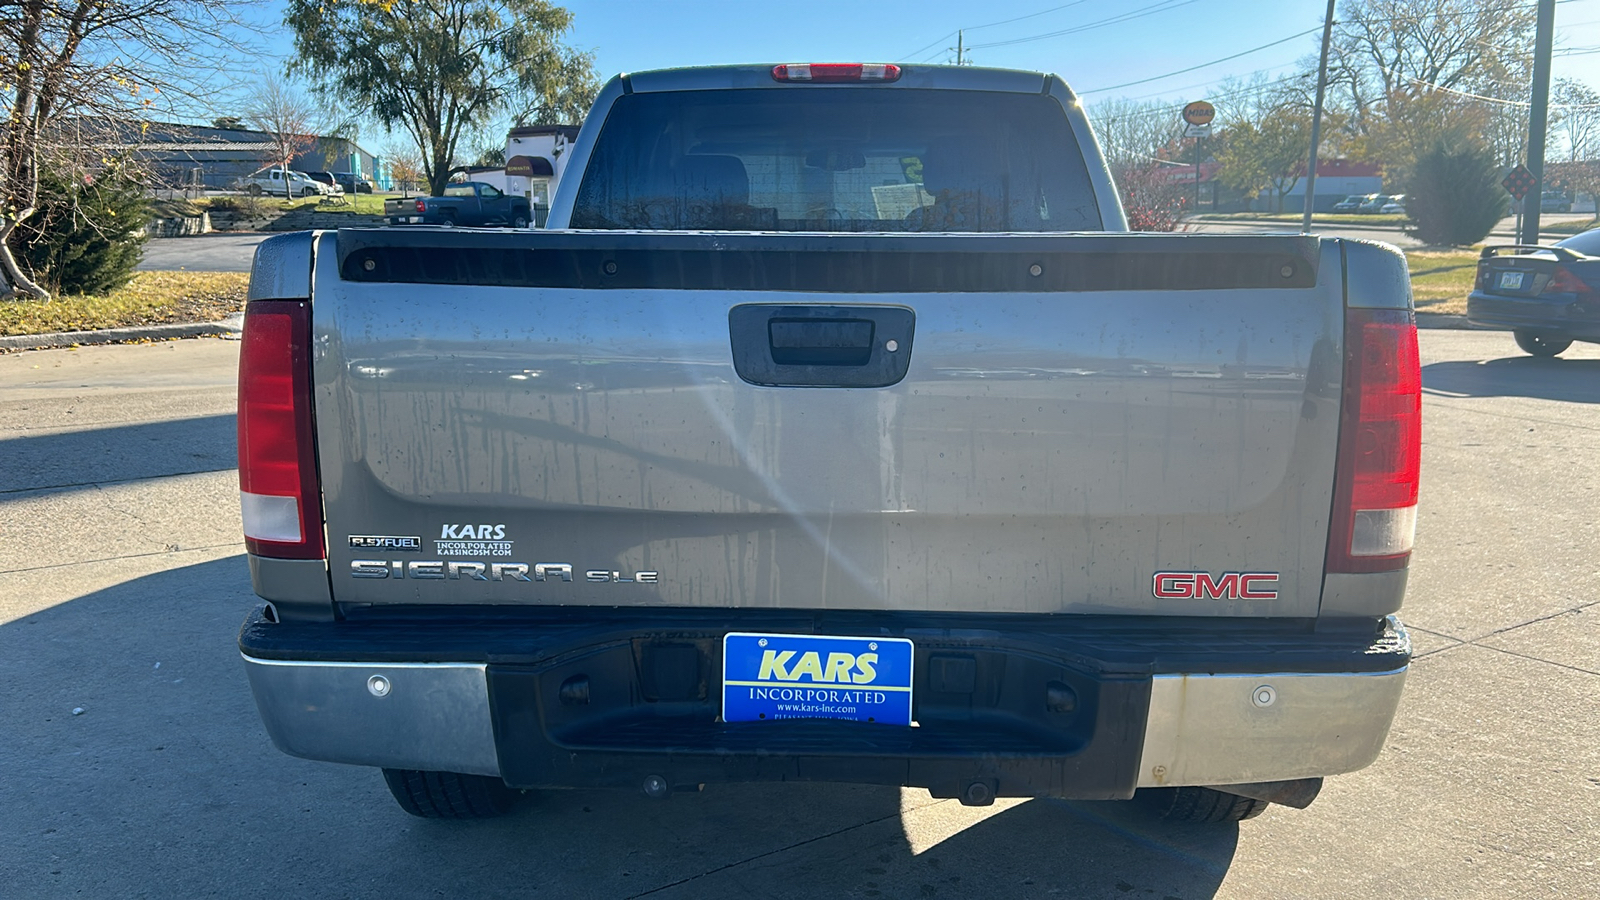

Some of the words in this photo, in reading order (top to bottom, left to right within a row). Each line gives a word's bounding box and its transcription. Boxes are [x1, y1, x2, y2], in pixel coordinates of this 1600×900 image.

[1188, 109, 1214, 117] MIDAS
[441, 524, 506, 540] KARS
[352, 538, 418, 547] FLEXFUEL
[437, 542, 512, 550] INCORPORATED
[350, 560, 574, 582] SIERRA
[586, 570, 658, 583] SLE
[1153, 572, 1279, 600] GMC
[757, 649, 879, 684] KARS
[750, 687, 886, 704] INCORPORATED
[777, 703, 856, 714] www.kars-inc.com
